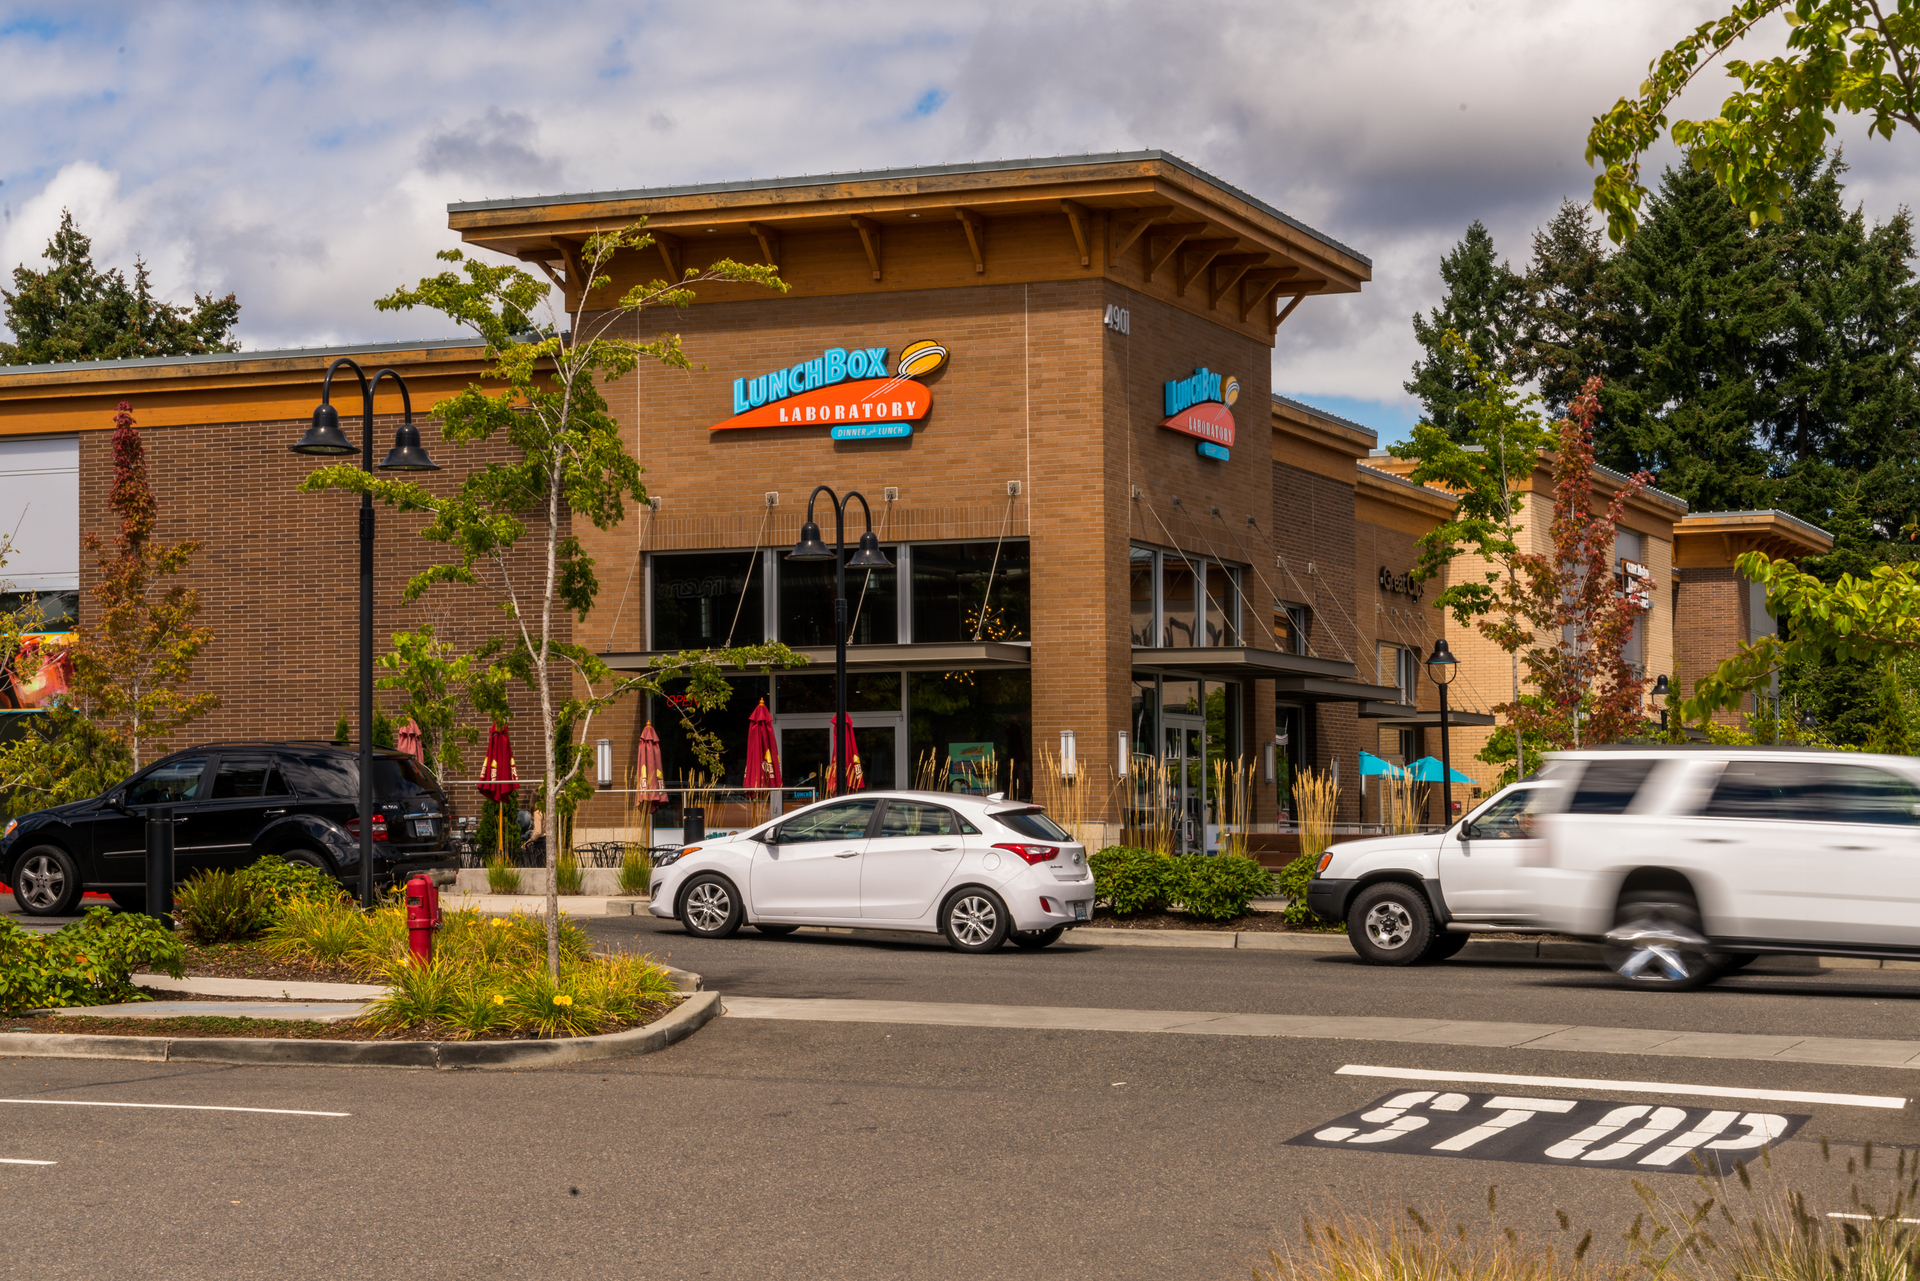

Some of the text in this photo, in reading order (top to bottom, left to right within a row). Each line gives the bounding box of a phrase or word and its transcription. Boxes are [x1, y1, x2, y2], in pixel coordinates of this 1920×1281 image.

[1104, 304, 1130, 336] 4901
[734, 347, 890, 415] LUNCHBOX
[780, 401, 917, 423] LABORATORY
[838, 426, 904, 437] DINNER and LUNCH
[1188, 416, 1233, 443] LABORATORY
[1381, 566, 1407, 593] Great
[666, 694, 699, 708] OPEN
[1314, 1091, 1788, 1166] STOP
